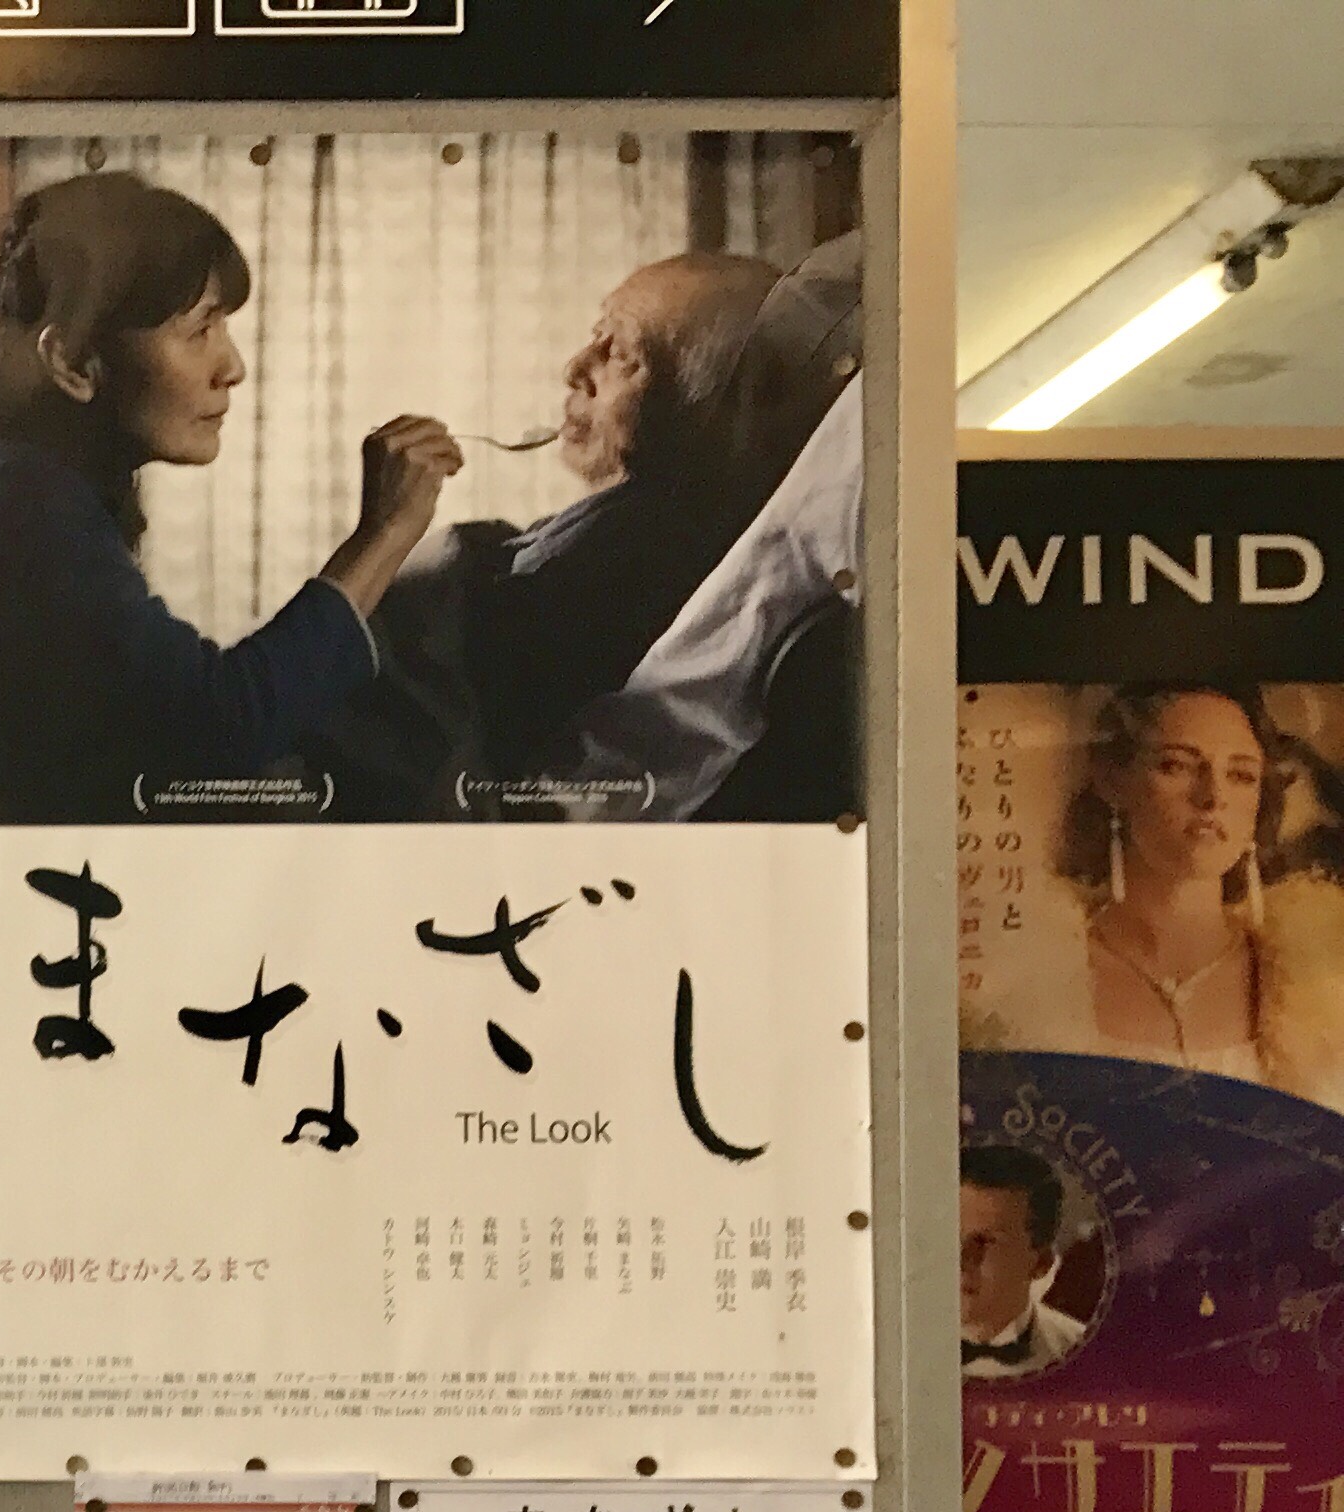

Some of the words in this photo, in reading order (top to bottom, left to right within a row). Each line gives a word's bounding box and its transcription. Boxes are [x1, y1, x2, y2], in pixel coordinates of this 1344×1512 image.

[957, 534, 1325, 605] WIND
[24, 860, 772, 1165] まなざし
[457, 1112, 519, 1144] The
[530, 1112, 612, 1144] Look
